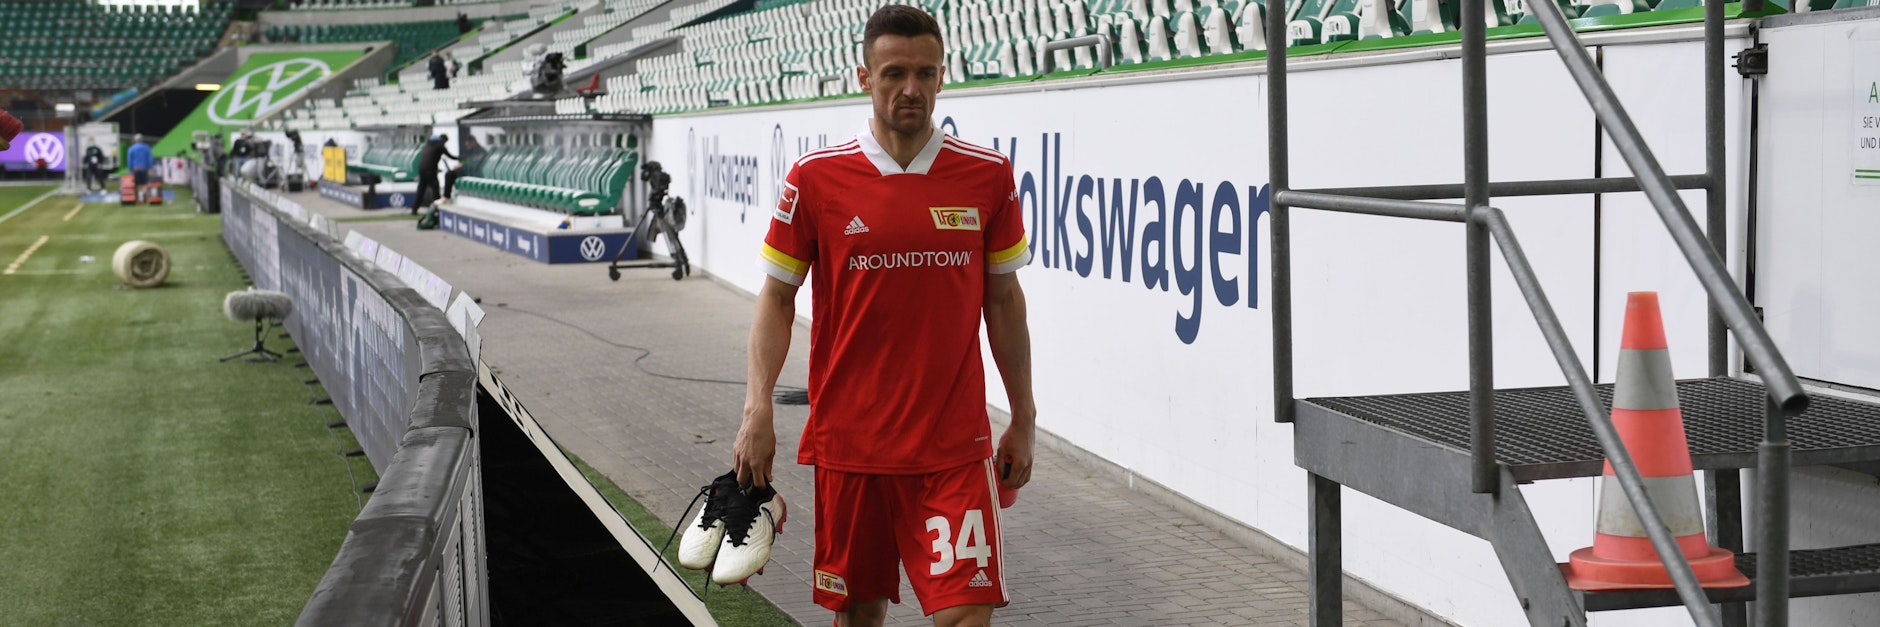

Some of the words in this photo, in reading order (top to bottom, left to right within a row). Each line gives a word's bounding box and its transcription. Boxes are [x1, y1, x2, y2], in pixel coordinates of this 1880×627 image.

[1863, 116, 1873, 128] SIE
[1860, 137, 1876, 149] UND
[703, 134, 760, 224] Volkswagen
[960, 215, 978, 226] UNION
[844, 226, 870, 235] adidas
[849, 250, 973, 270] AROUNDTOWN
[925, 509, 992, 575] 34
